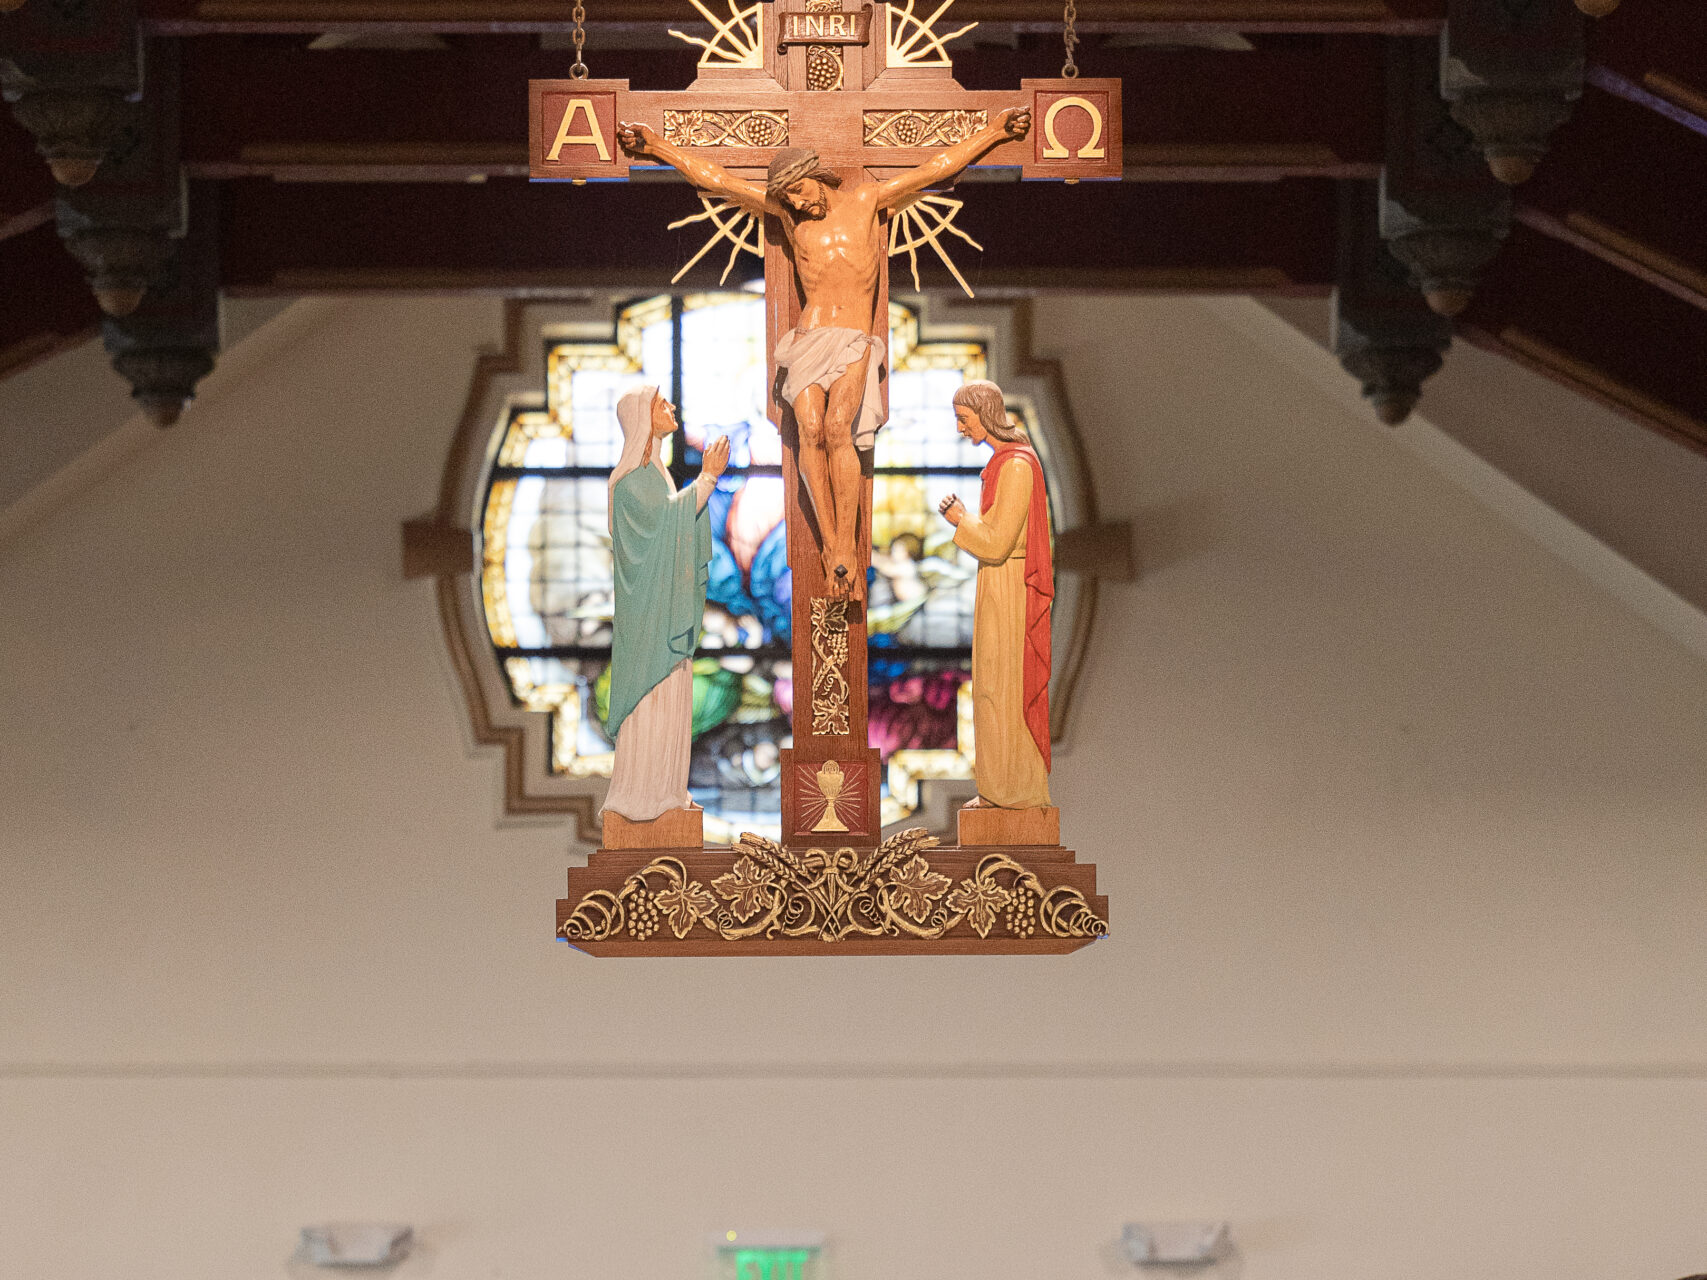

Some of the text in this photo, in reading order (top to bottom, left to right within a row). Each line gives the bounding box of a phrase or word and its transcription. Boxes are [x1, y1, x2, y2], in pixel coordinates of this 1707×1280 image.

[793, 14, 856, 37] INRI
[545, 98, 612, 161] A
[1042, 96, 1105, 159] Ω
